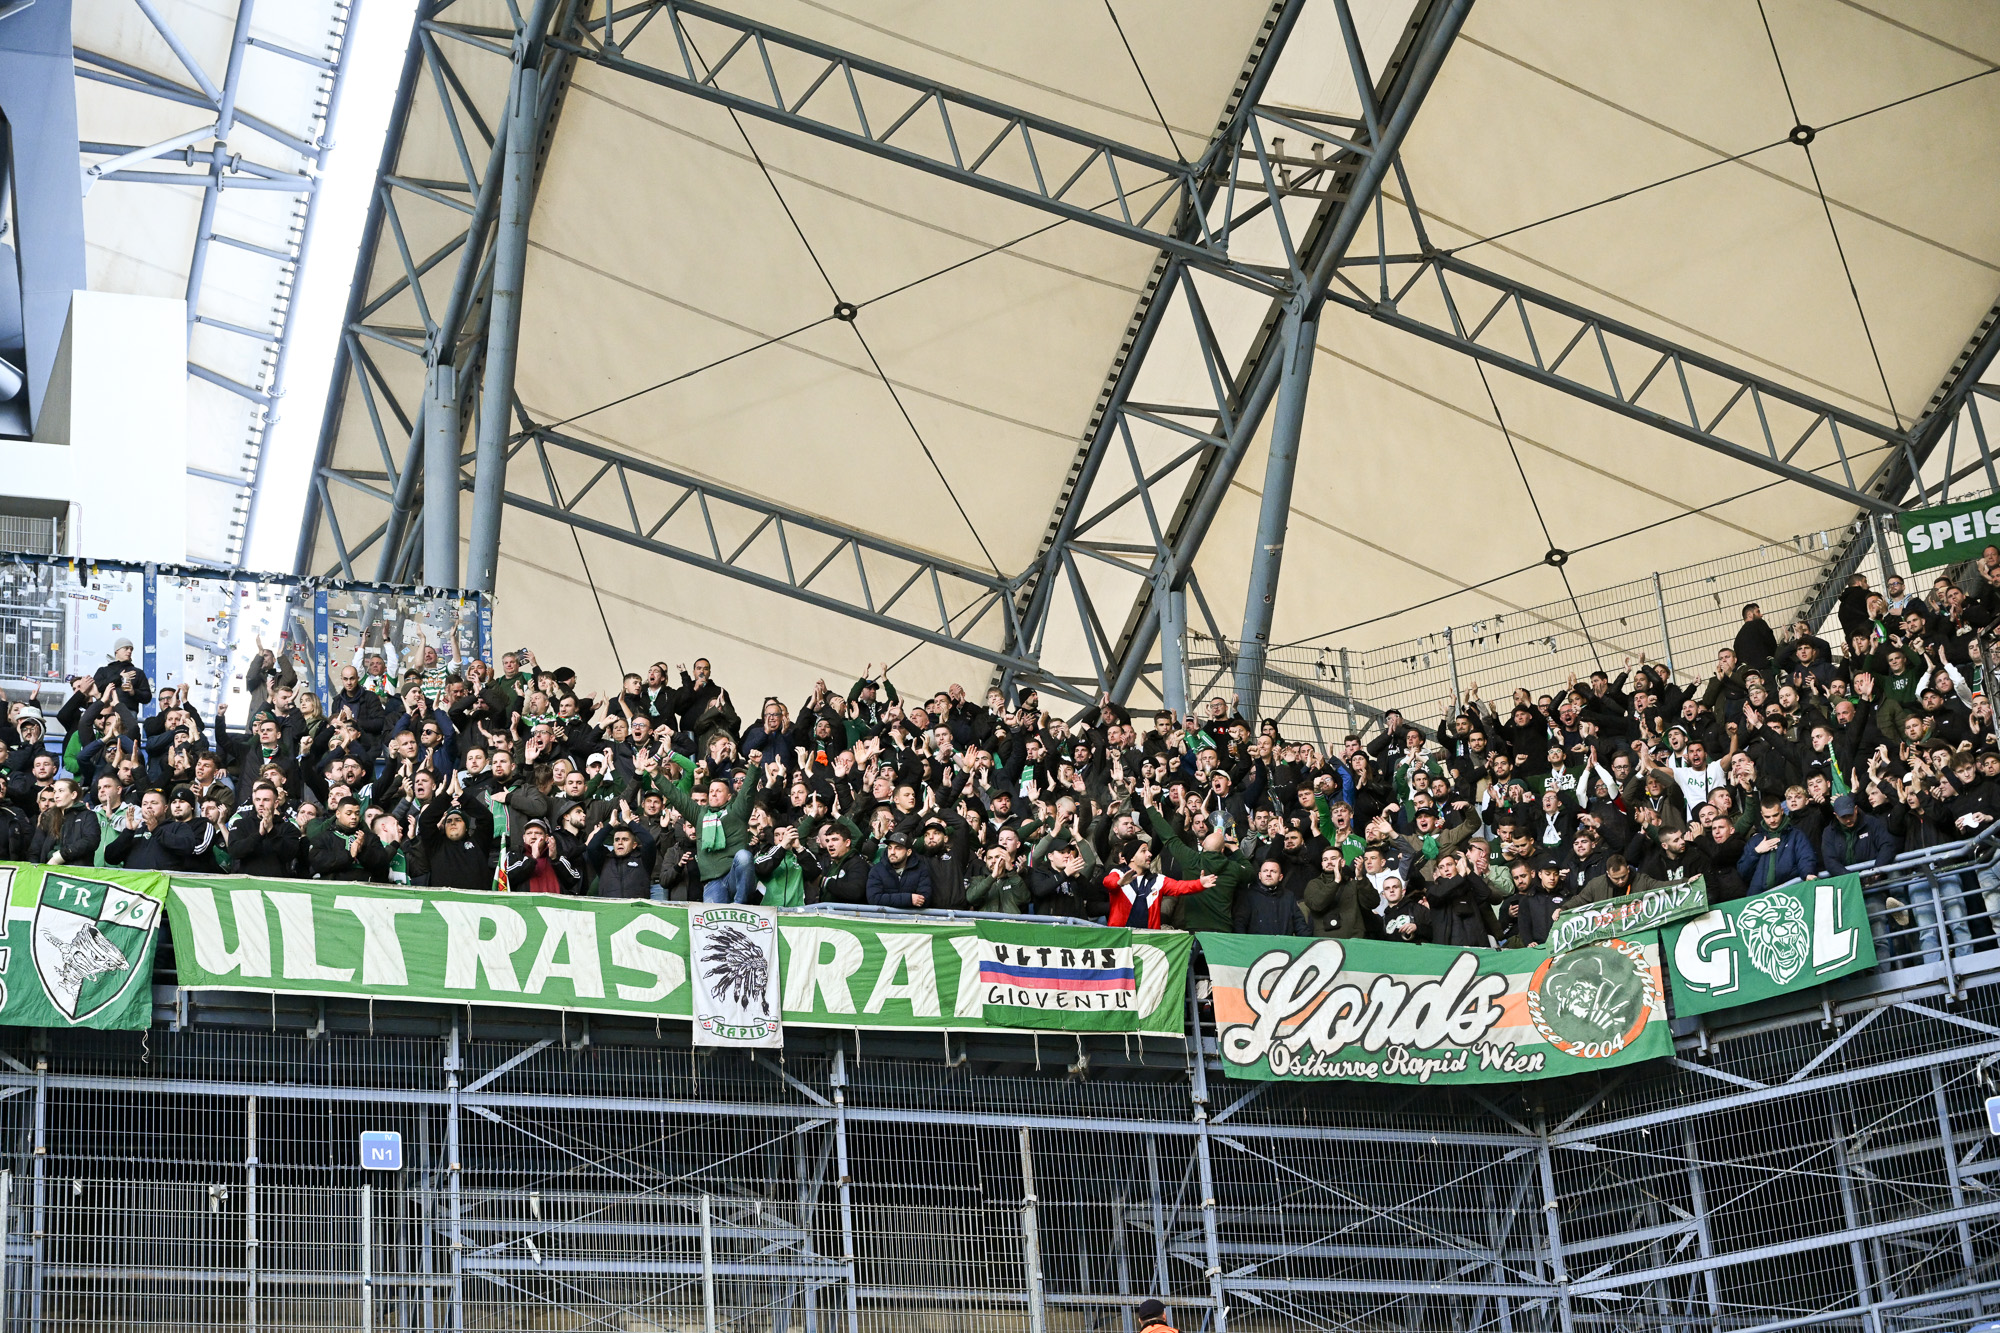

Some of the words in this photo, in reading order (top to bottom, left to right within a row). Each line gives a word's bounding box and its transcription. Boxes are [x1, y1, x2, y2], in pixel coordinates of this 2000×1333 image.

[56, 881, 91, 907] TR
[115, 900, 144, 919] 96
[705, 911, 756, 924] ULTRAS
[1552, 903, 1614, 953] LORDS
[170, 885, 686, 1002] ULTRAS
[995, 944, 1116, 968] ULTRAS
[1617, 940, 1663, 1011] Rapid
[1221, 938, 1509, 1067] Lords
[715, 1025, 766, 1037] RAPID
[1528, 990, 1563, 1045] since
[1565, 1032, 1625, 1059] 2004
[1268, 1039, 1379, 1080] Ostkurve
[1382, 1043, 1468, 1083] Rapid
[1472, 1041, 1546, 1073] Wien
[372, 1148, 392, 1160] N1
